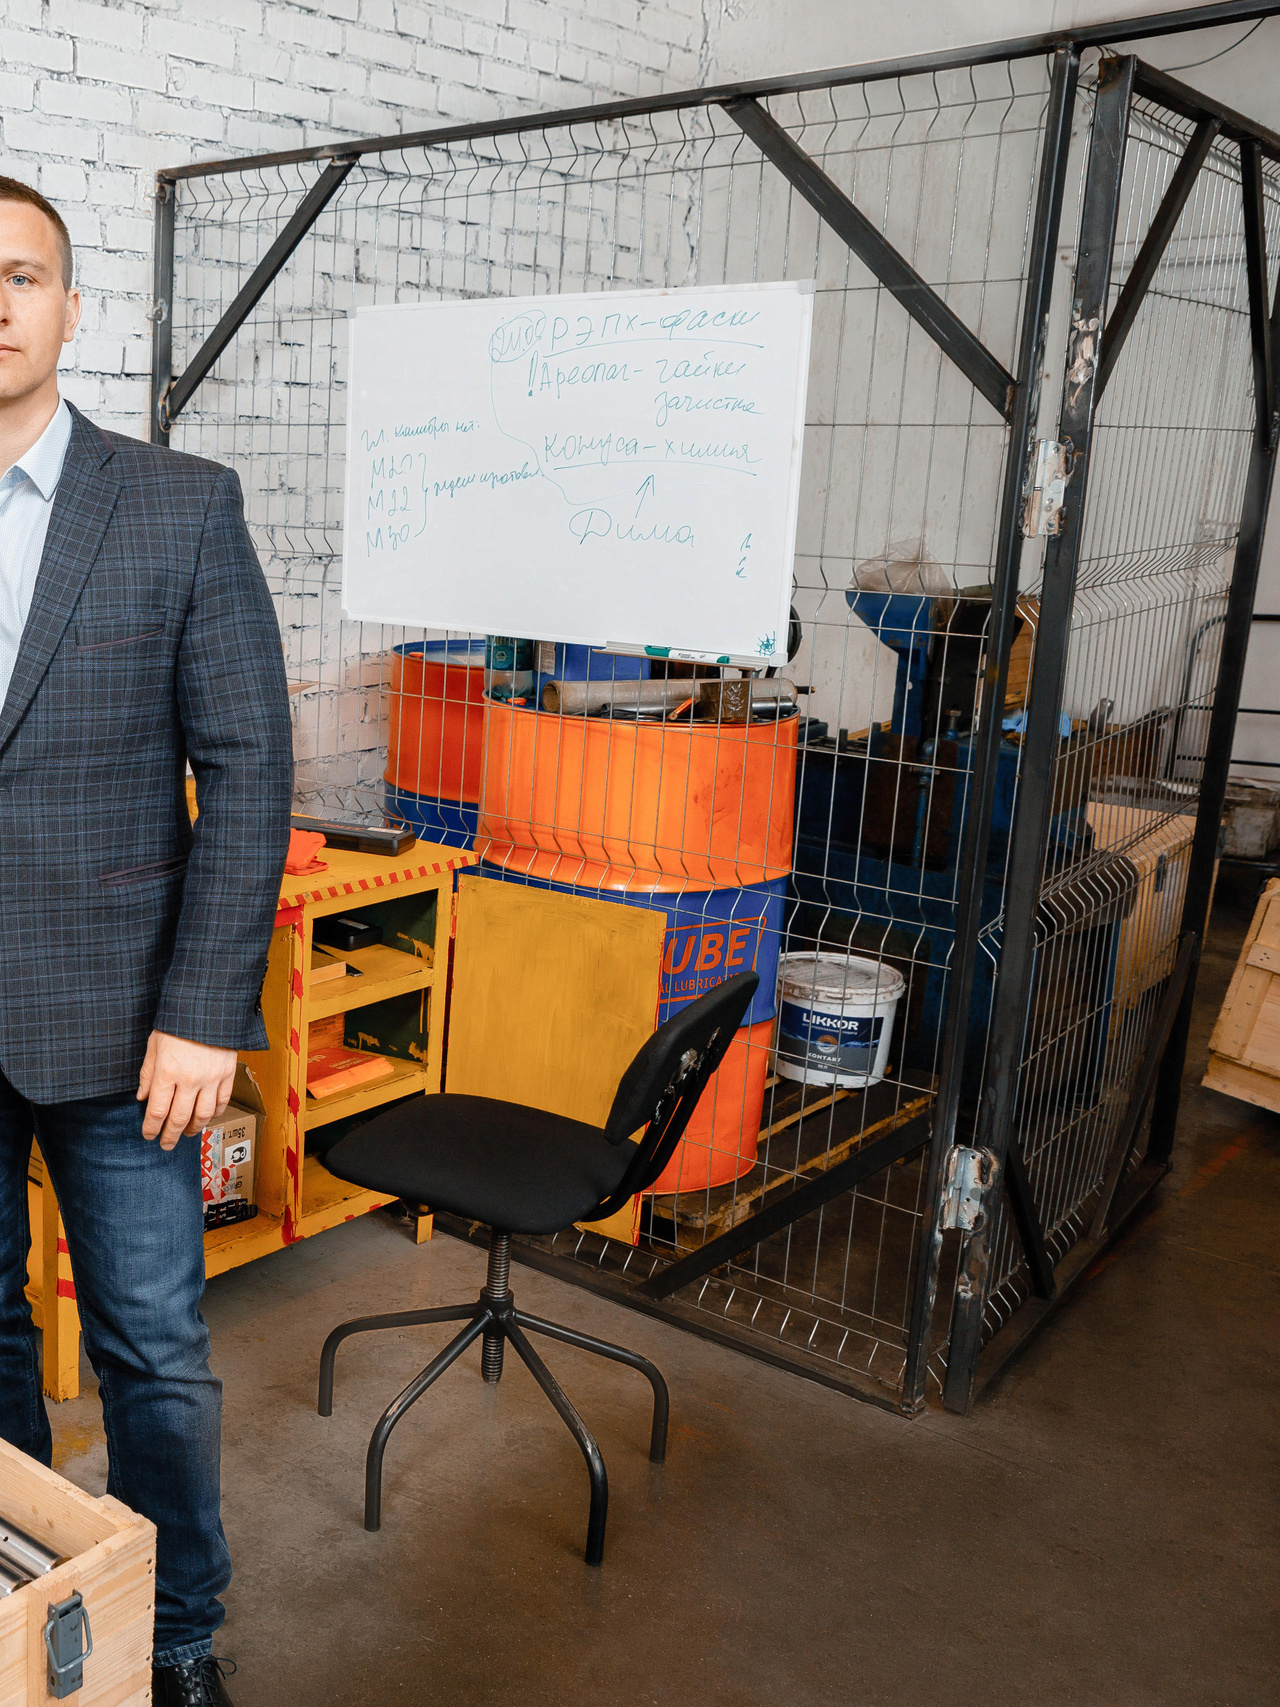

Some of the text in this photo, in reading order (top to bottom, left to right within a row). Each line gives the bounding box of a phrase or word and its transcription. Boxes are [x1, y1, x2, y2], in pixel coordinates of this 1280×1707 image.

[568, 508, 694, 548] Дима
[674, 972, 739, 992] LUBRICA
[802, 1013, 859, 1031] LIKKOR
